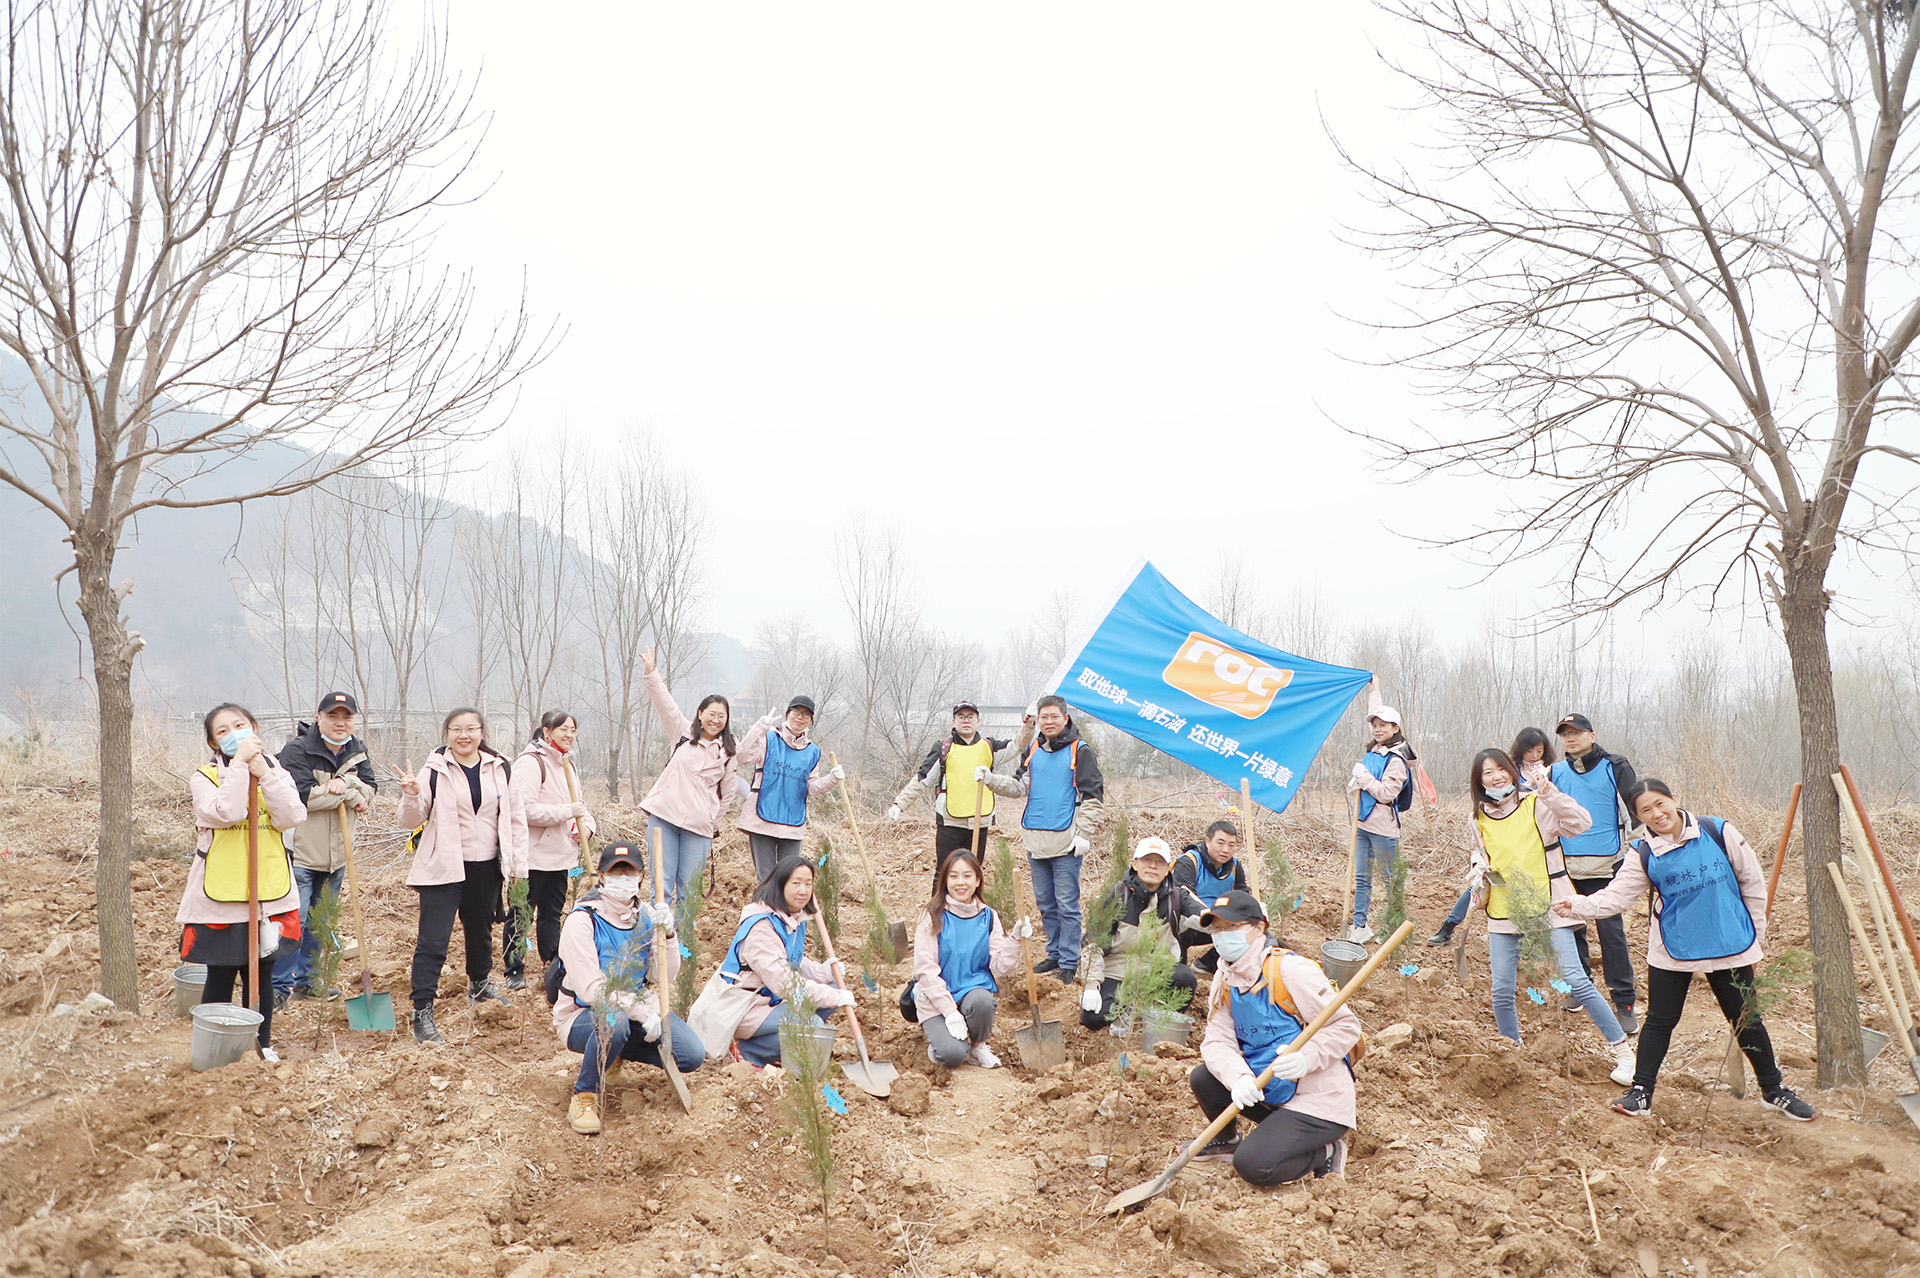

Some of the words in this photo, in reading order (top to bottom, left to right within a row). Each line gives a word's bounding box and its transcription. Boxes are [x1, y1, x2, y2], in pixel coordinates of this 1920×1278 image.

[1184, 640, 1284, 696] roc
[1077, 667, 1187, 734] 取地球一滴石油
[1187, 723, 1294, 788] 还世界一片绿意
